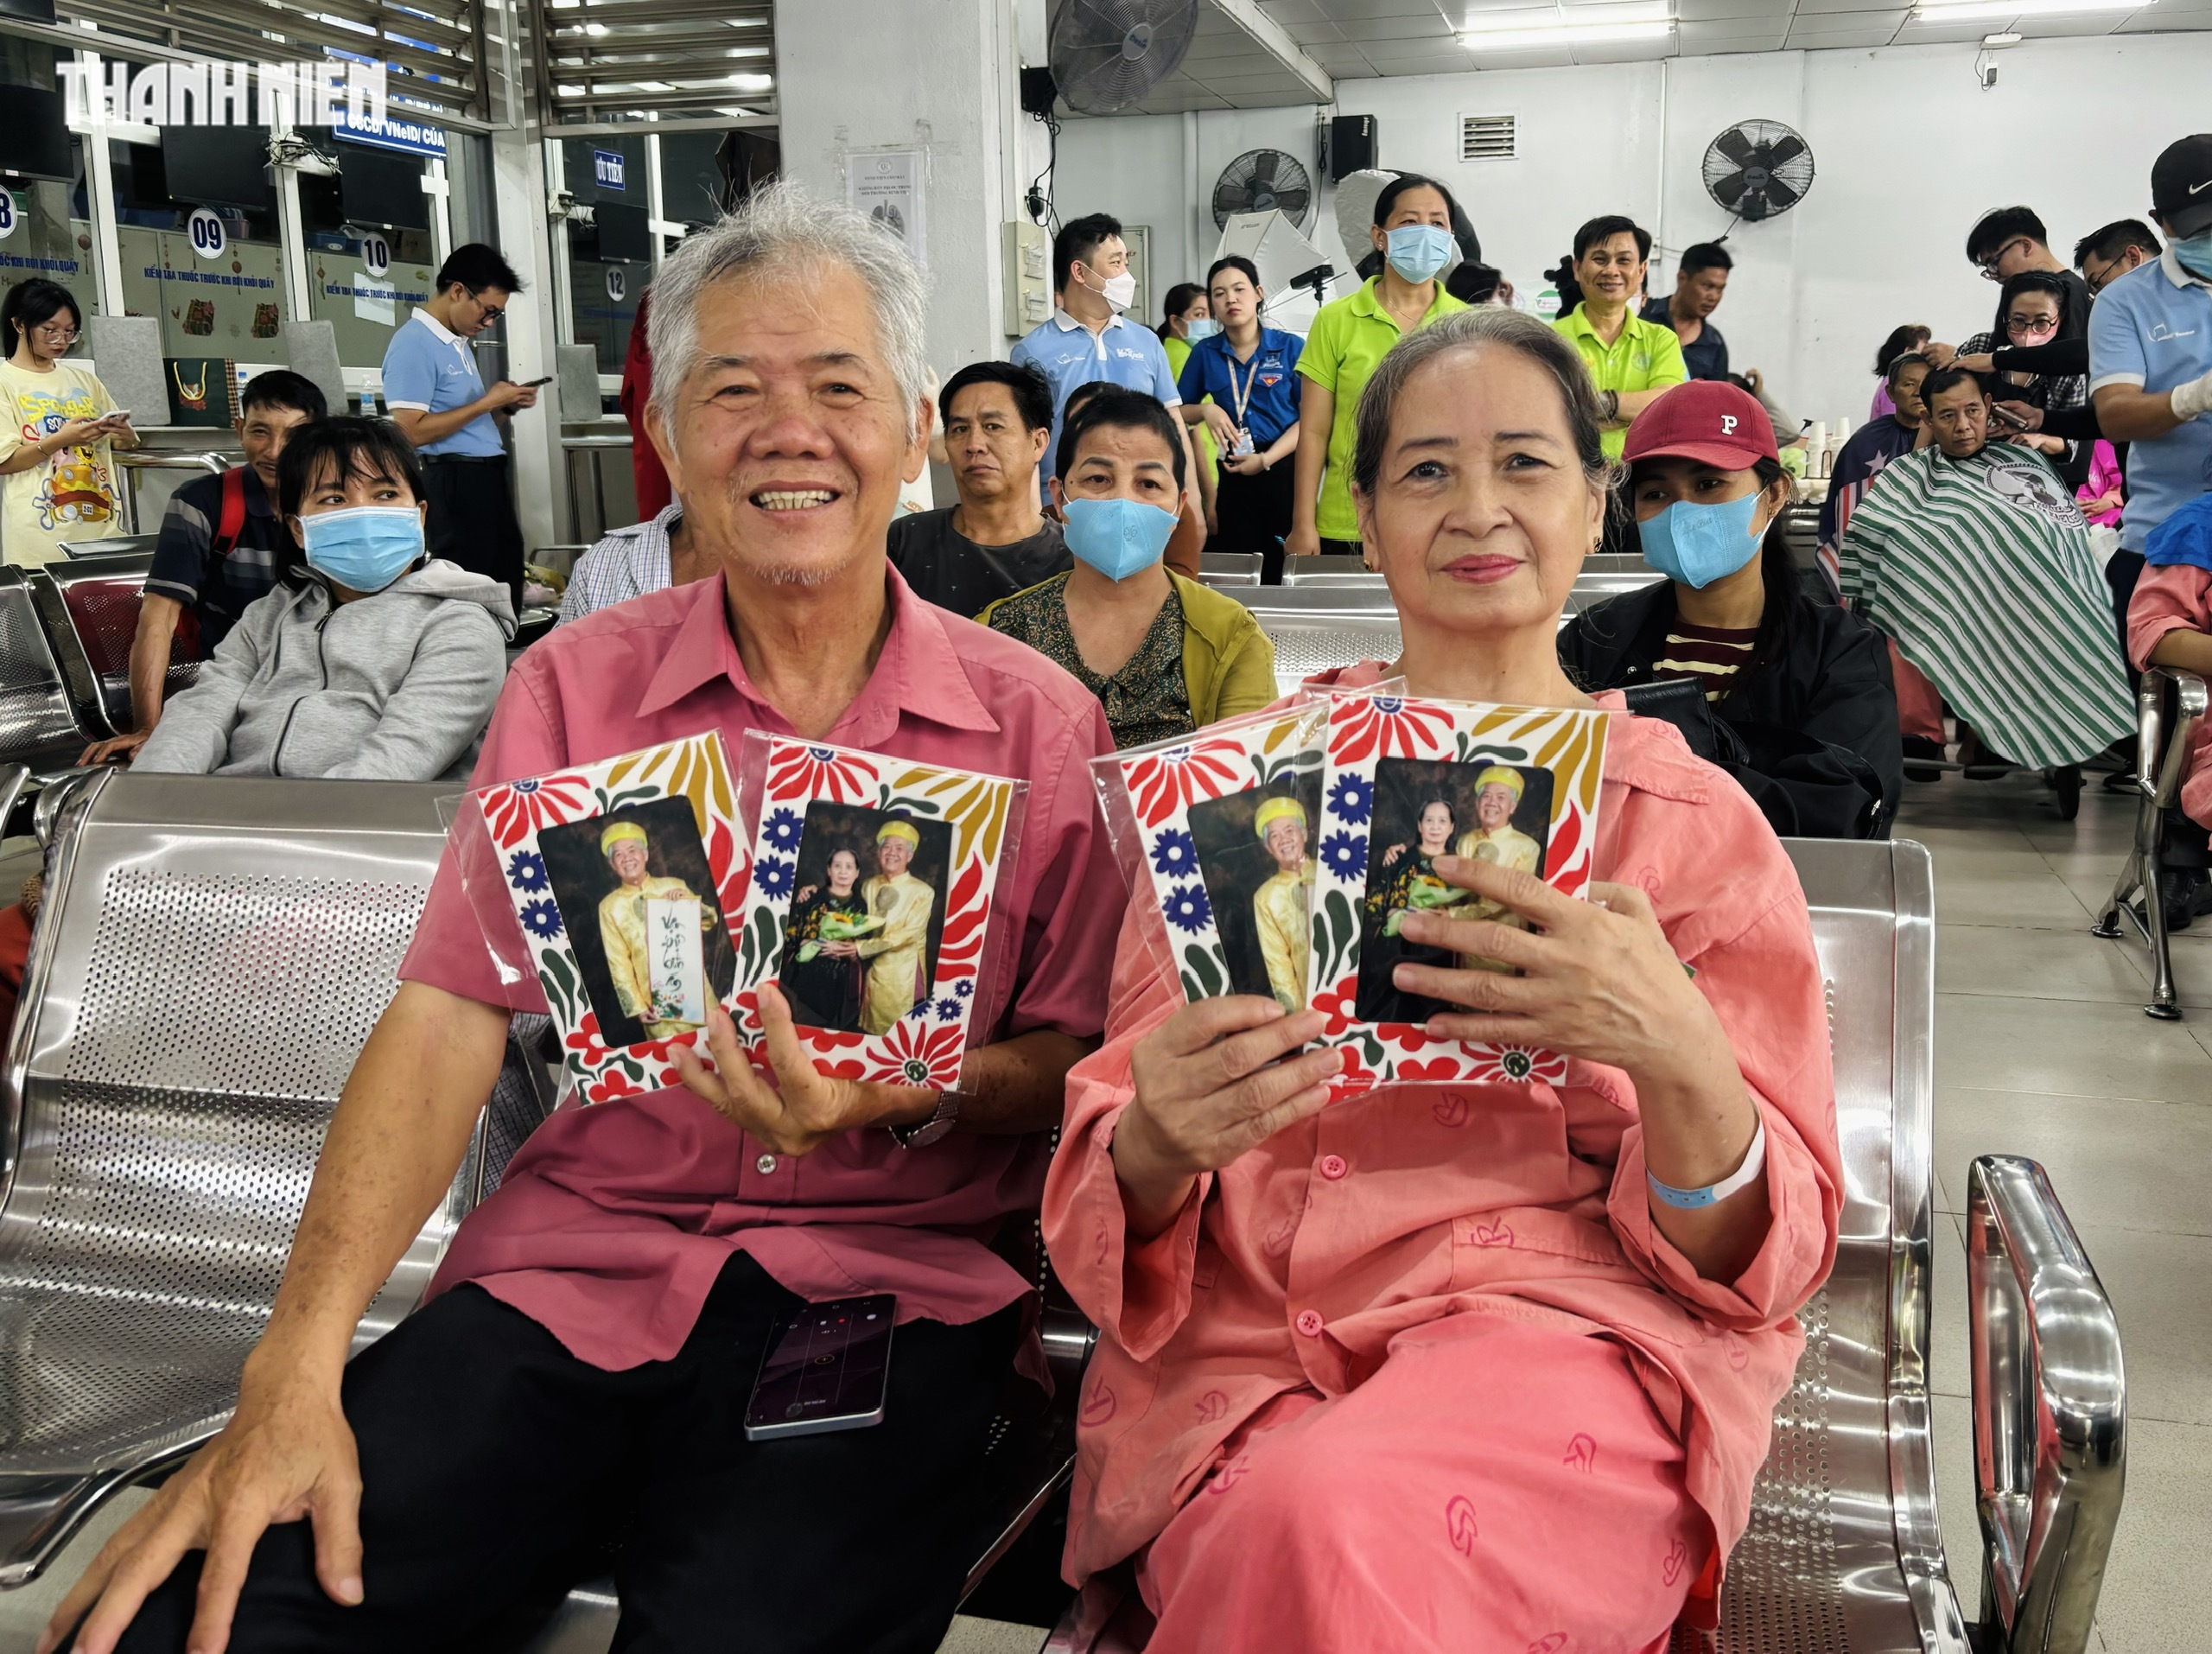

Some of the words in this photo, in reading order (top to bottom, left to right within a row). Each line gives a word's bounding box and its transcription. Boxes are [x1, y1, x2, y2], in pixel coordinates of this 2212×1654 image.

[193, 217, 222, 250] 09
[365, 239, 388, 269] 10
[608, 271, 623, 295] 12
[1720, 415, 1738, 436] P
